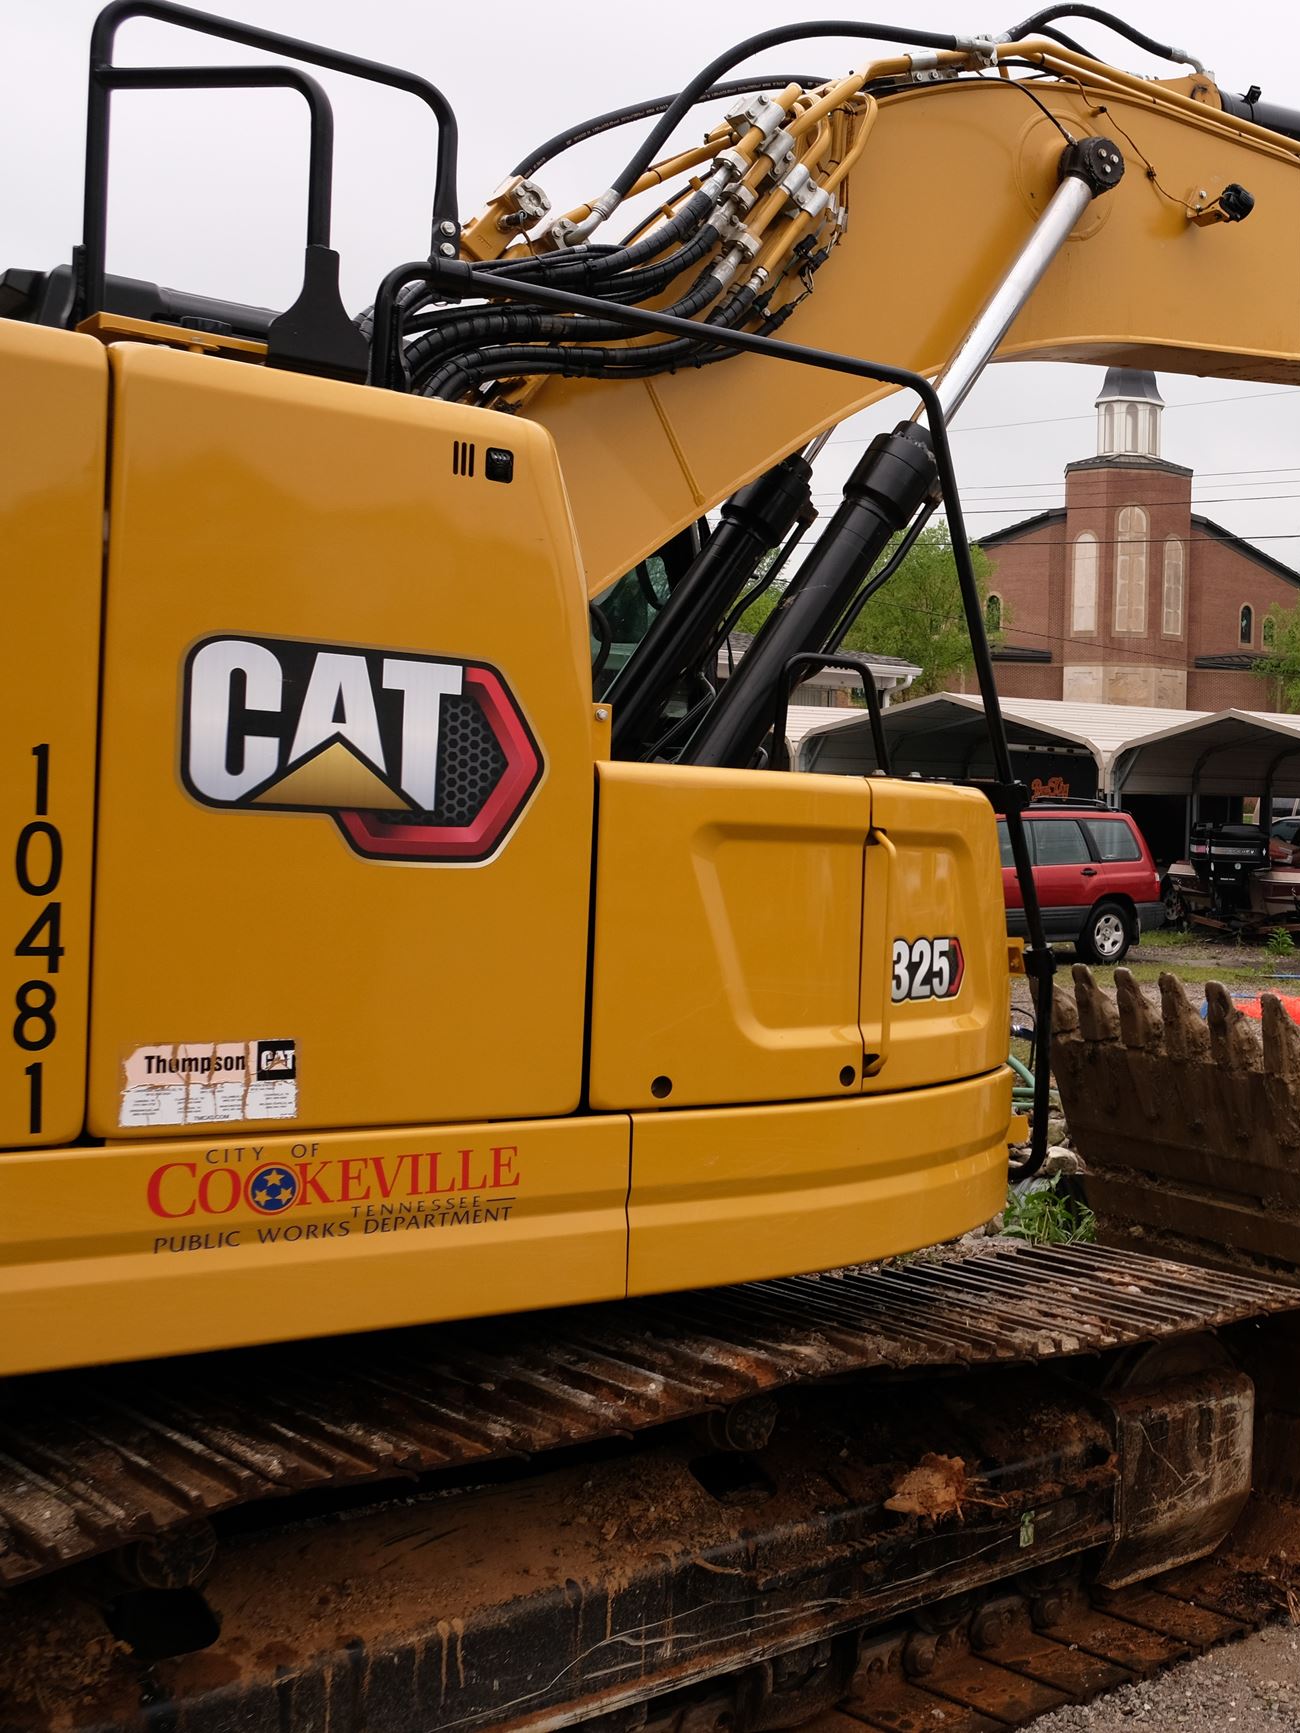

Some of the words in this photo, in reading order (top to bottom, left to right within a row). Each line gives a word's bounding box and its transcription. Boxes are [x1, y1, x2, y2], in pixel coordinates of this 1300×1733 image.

[188, 639, 463, 812] CAT
[12, 743, 65, 1135] 10481
[891, 939, 950, 1001] 325
[144, 1055, 246, 1074] Thompson
[260, 1049, 296, 1071] CAT
[205, 1146, 264, 1164] CITY
[291, 1143, 319, 1159] OF
[147, 1146, 521, 1219] COOKEVILLE
[352, 1195, 481, 1218] TENNESSEE
[153, 1230, 241, 1254] PUBLIC
[257, 1220, 350, 1243] WORKS
[363, 1206, 513, 1235] DEPARTMENT
